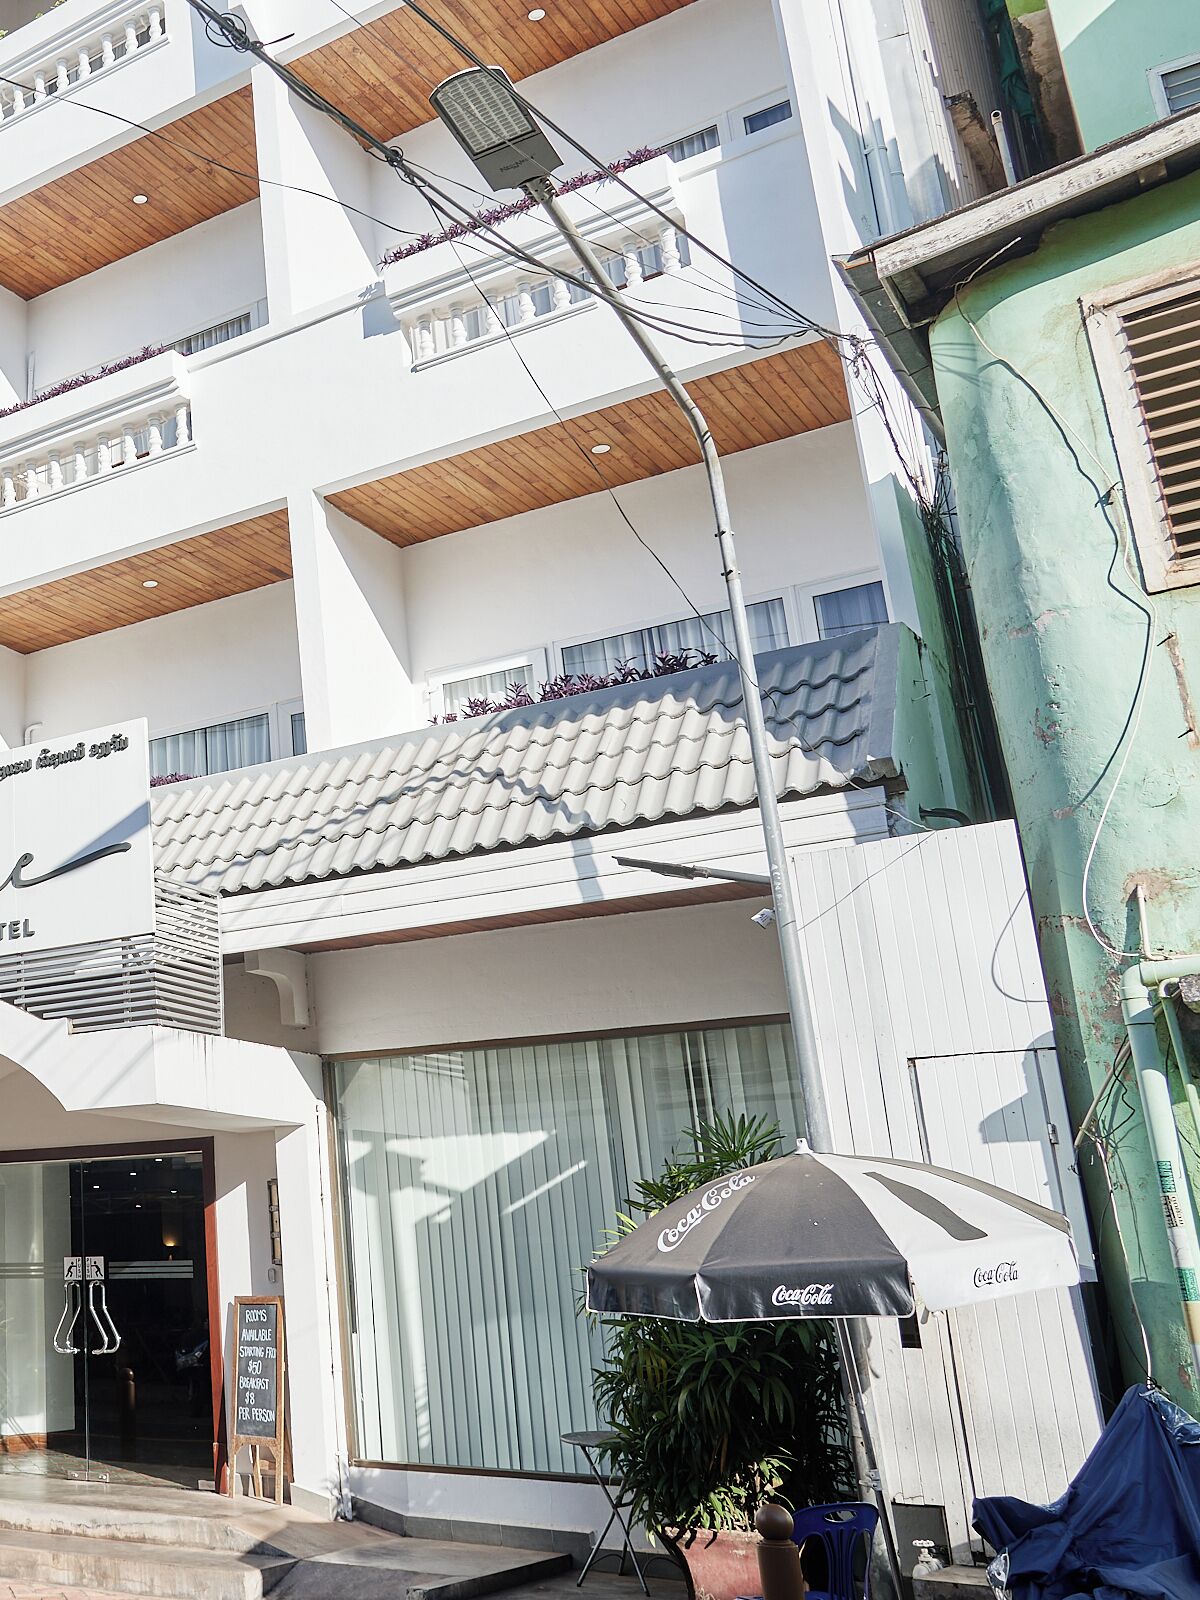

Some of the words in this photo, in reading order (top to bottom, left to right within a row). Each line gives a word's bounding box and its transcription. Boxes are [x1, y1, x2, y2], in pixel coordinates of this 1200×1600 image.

[657, 1173, 757, 1253] Coca-Cola
[973, 1260, 1018, 1288] Coca-Cola
[771, 1283, 835, 1306] Coca-Cola
[245, 1309, 268, 1323] ROOMS
[241, 1328, 273, 1342] AVAILABLE
[239, 1346, 265, 1358] STARTING
[247, 1359, 262, 1375] $50
[239, 1376, 269, 1390] BREAKFAST
[245, 1391, 255, 1405] $8
[238, 1406, 250, 1421] PER
[251, 1408, 275, 1423] PERSON
